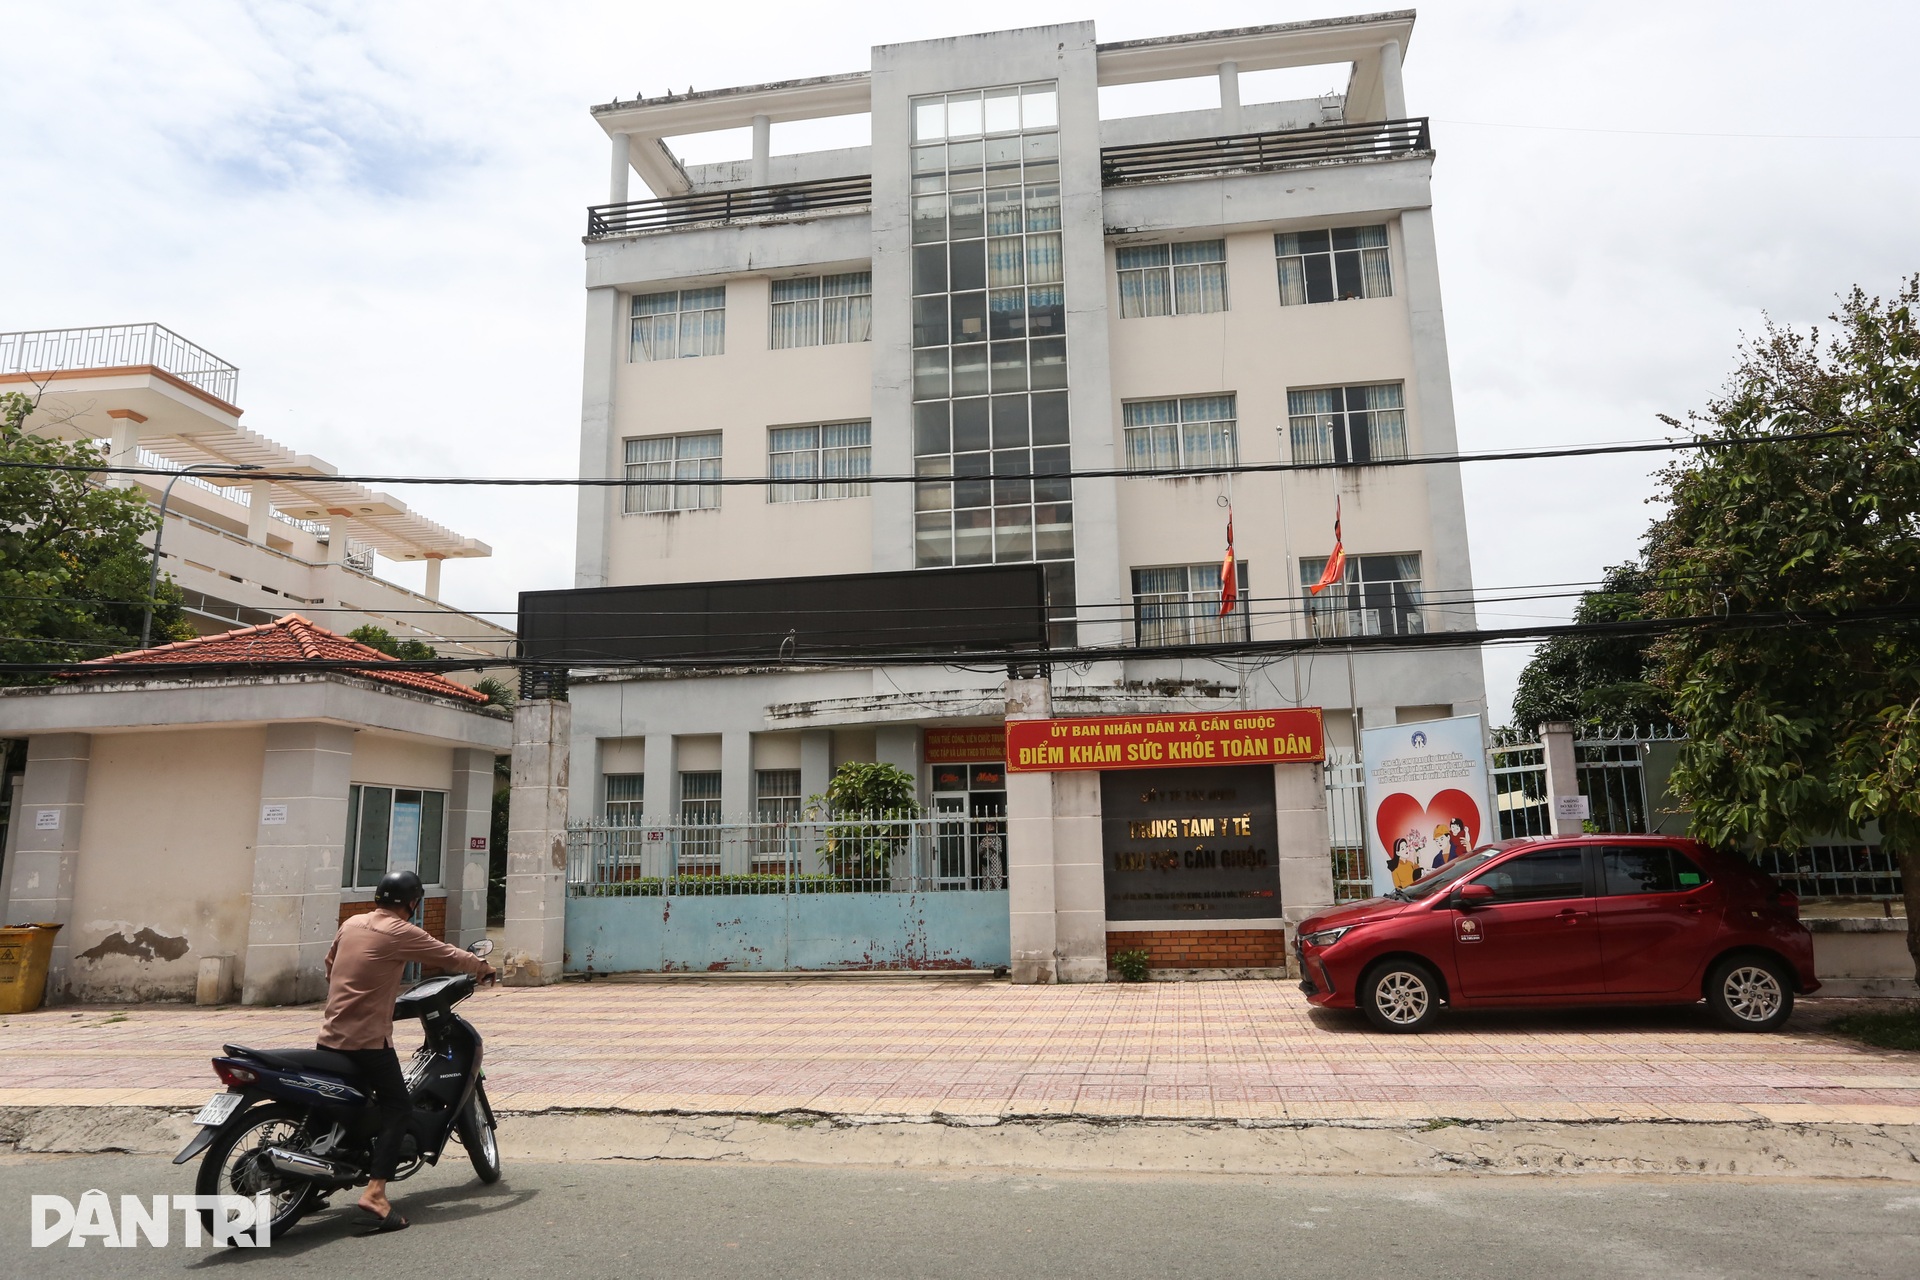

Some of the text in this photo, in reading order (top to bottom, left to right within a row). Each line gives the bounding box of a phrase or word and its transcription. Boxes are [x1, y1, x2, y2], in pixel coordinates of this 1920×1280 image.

[1051, 715, 1276, 737] ỦY BAN NHÂN DÂN XÃ CẦN GIUỘC
[1019, 733, 1312, 765] ĐIỂM KHÁM SỨC KHỎE TOÀN DÂN
[1181, 815, 1215, 838] TÂM
[1218, 817, 1228, 837] Y
[1232, 811, 1252, 837] TẾ
[1184, 844, 1216, 869] CẦN
